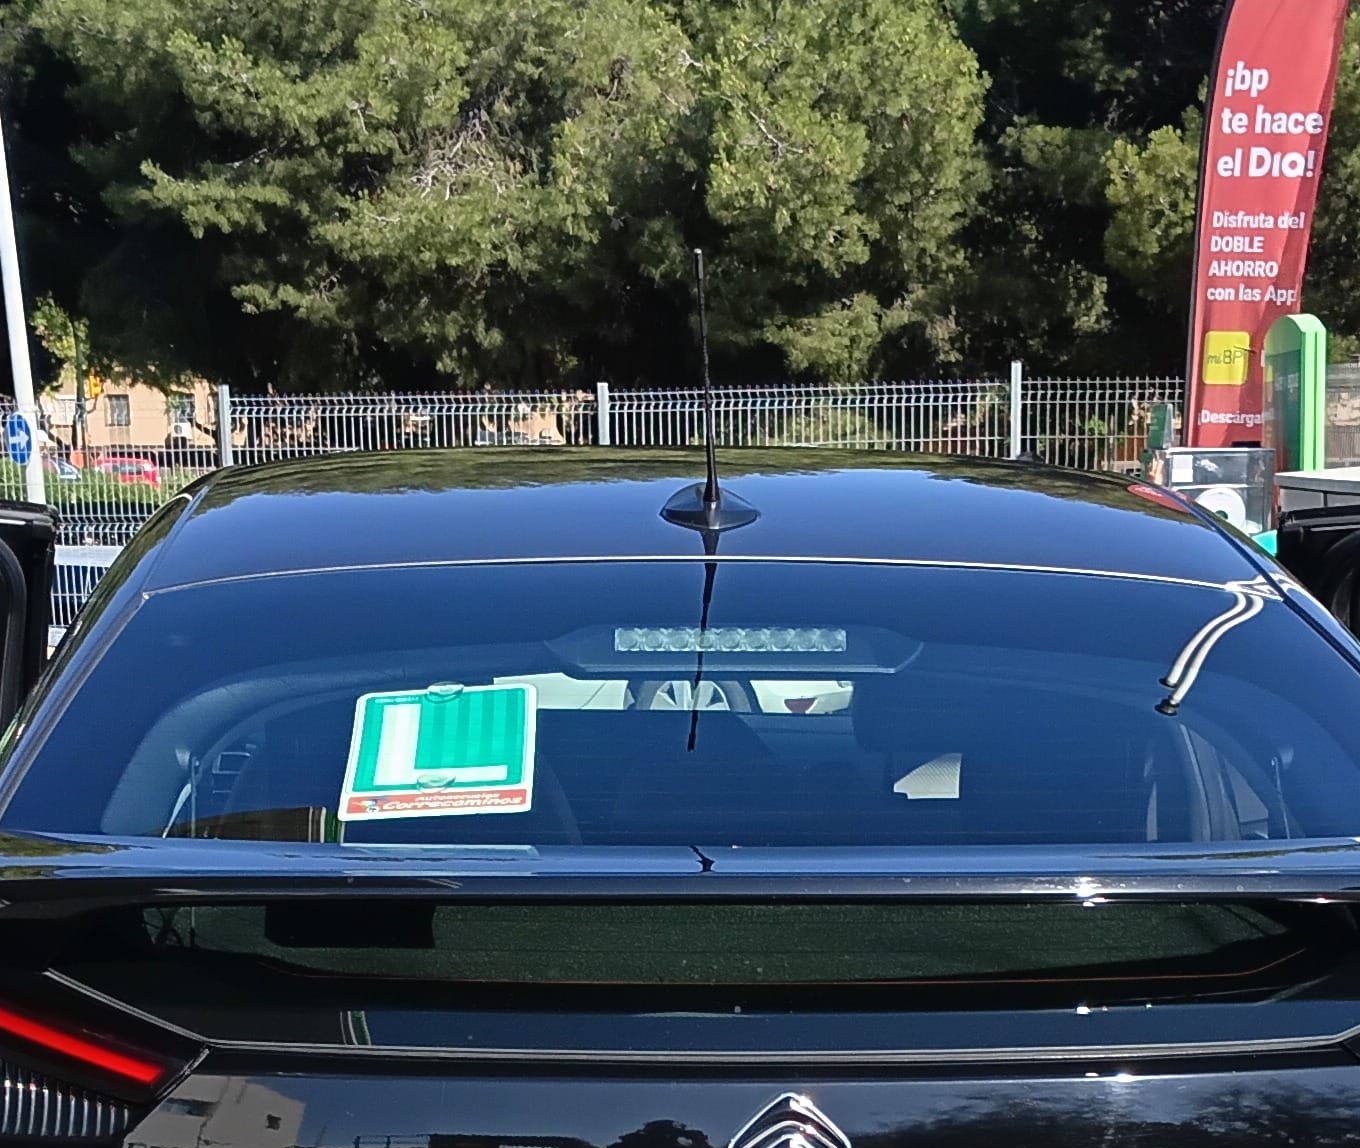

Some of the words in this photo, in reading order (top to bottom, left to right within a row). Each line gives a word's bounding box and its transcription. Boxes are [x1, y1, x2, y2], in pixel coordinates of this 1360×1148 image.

[1225, 61, 1269, 97] ¡bp
[1221, 107, 1248, 134] te
[1255, 104, 1323, 134] hace
[1217, 148, 1242, 177] el
[1212, 210, 1274, 229] Disfruta
[1277, 211, 1305, 229] del
[1210, 235, 1264, 253] DOBLE
[1208, 260, 1278, 278] AHORRO
[1207, 287, 1235, 301] con
[1238, 283, 1261, 301] las
[383, 796, 522, 810] Correcaminos
